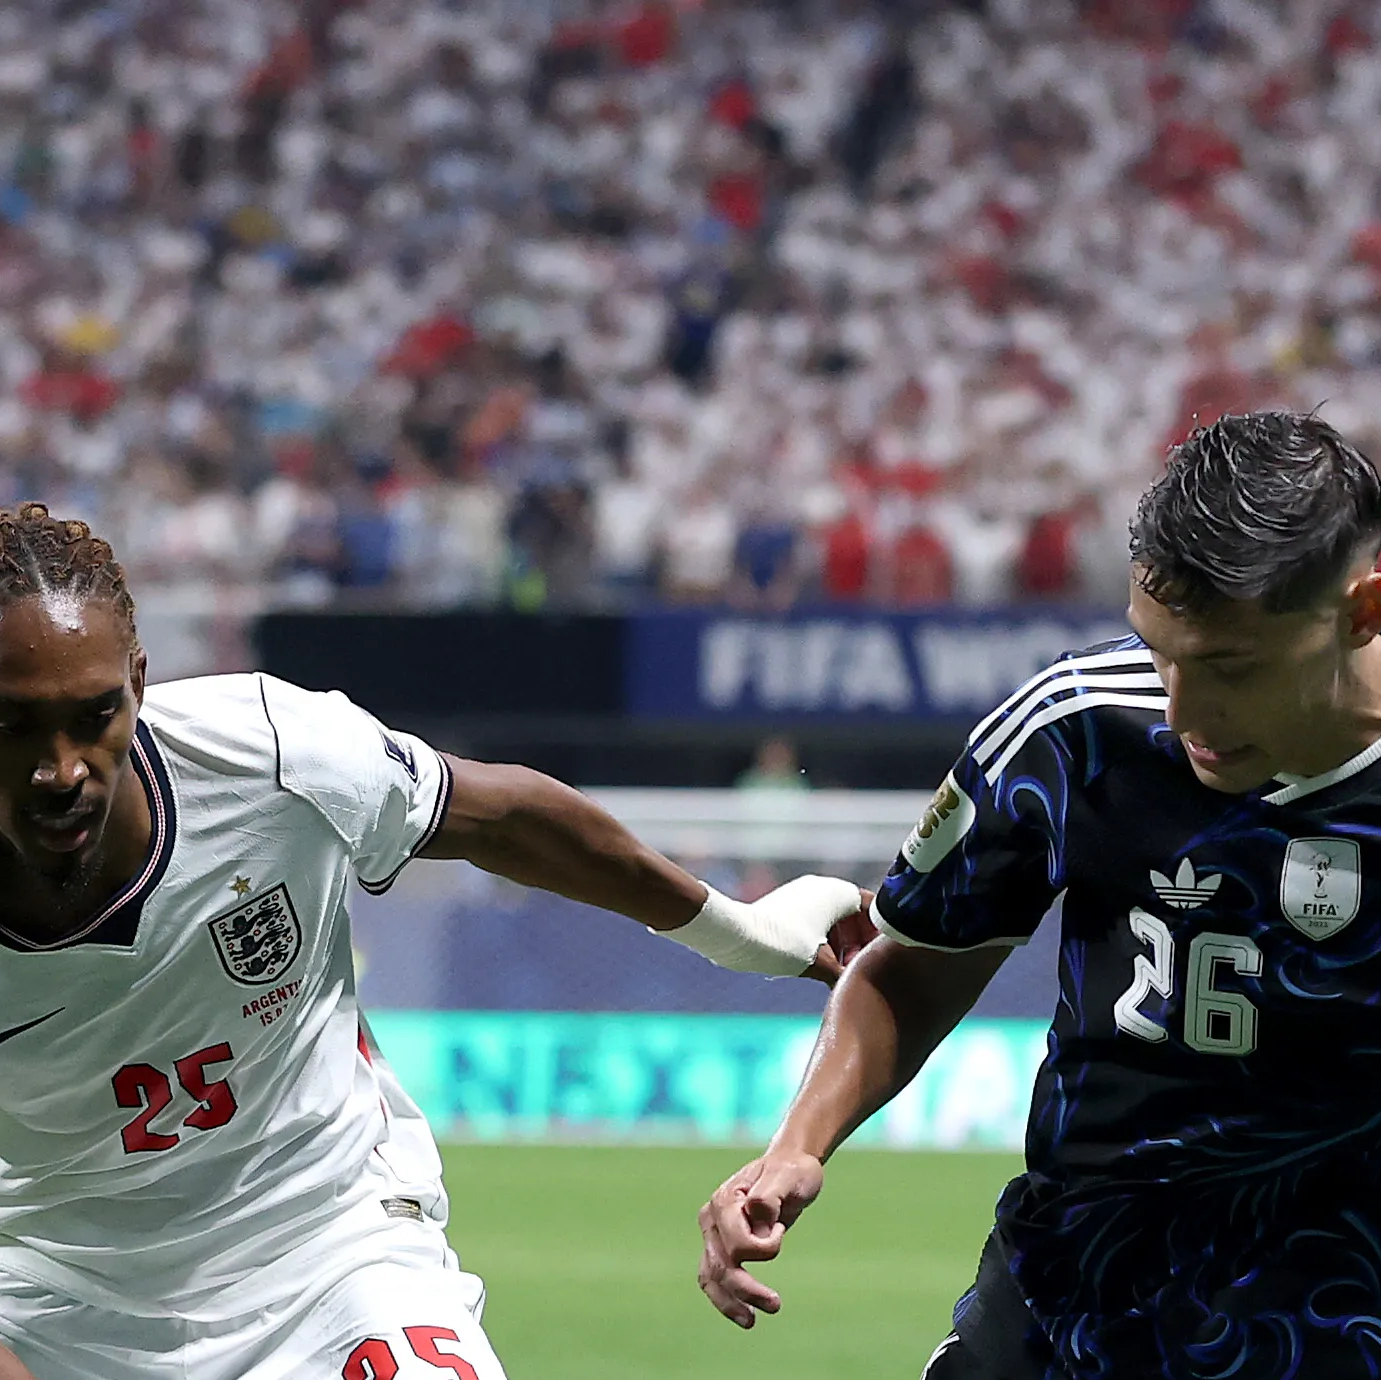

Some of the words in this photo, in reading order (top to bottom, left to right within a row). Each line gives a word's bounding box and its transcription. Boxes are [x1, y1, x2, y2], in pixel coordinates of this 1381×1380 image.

[702, 618, 912, 712] FIFA
[1303, 903, 1338, 917] FIFA
[1113, 905, 1264, 1056] 26
[110, 1041, 240, 1154] 25
